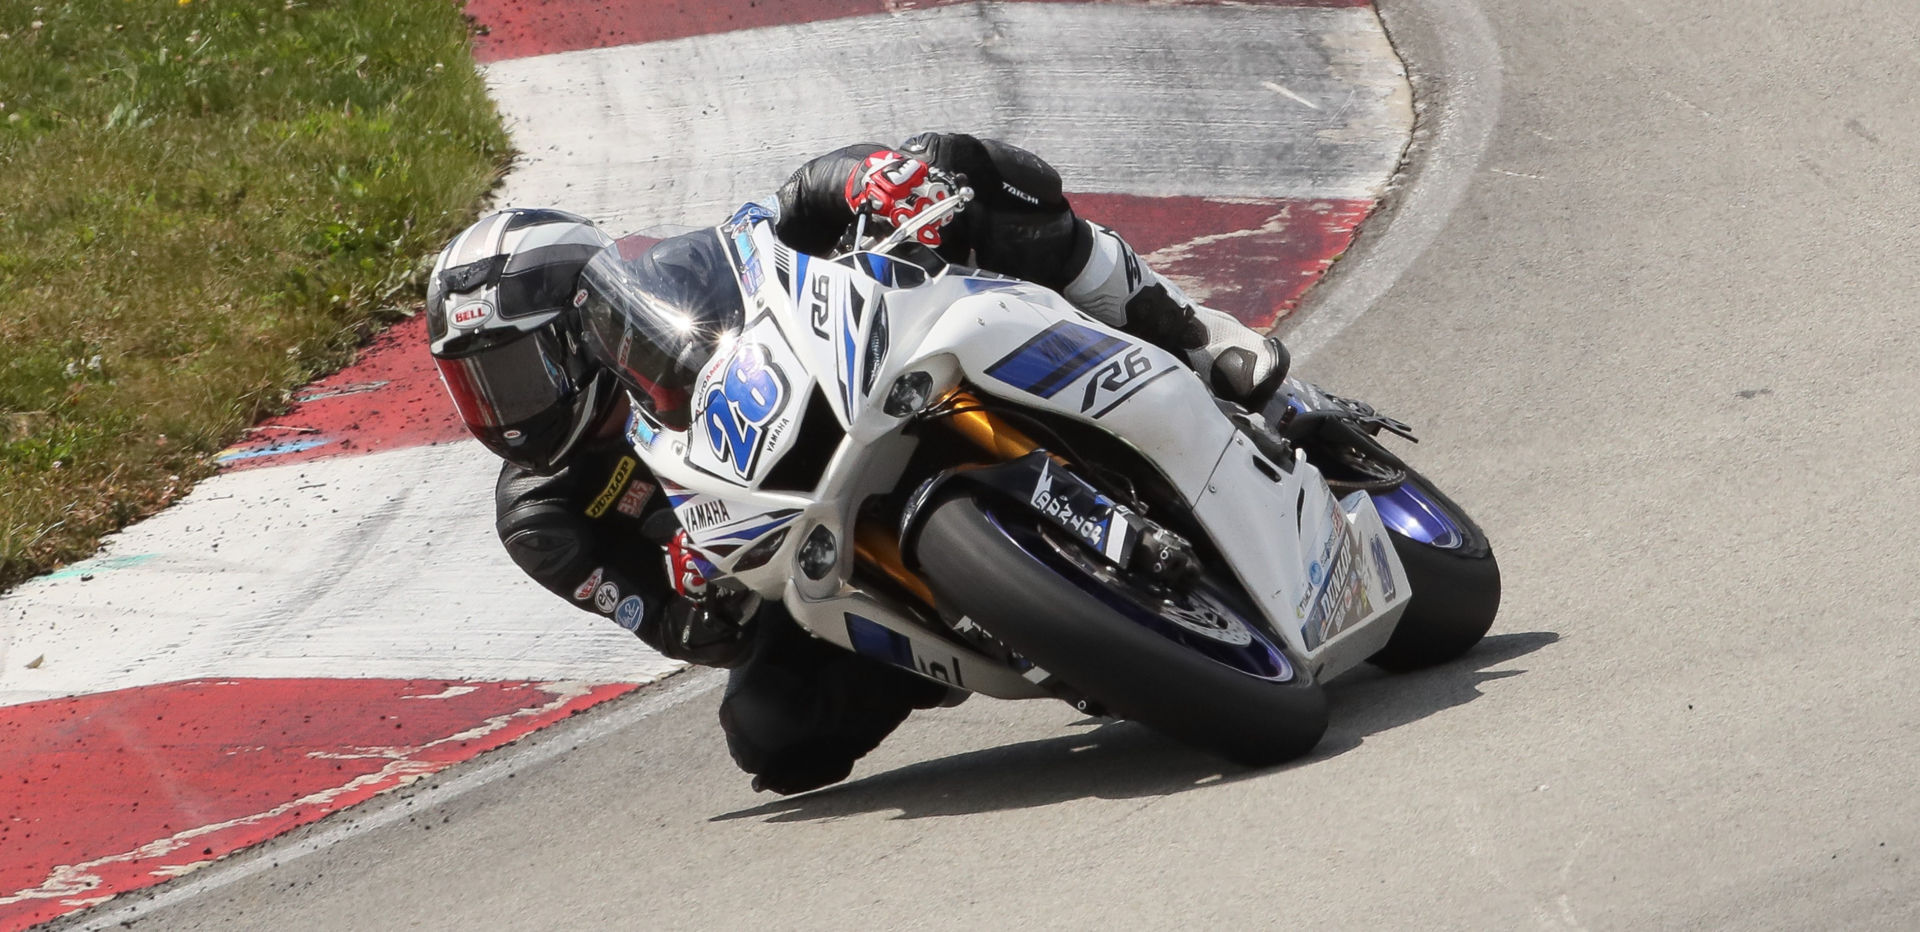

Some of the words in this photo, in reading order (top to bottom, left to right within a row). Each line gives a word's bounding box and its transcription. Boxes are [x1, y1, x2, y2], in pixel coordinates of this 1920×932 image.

[1001, 181, 1039, 205] TAICHI
[455, 307, 485, 324] BELL
[1080, 347, 1152, 413] R6
[705, 344, 787, 480] 28
[766, 418, 790, 453] YAMAHA
[591, 460, 631, 516] DUNLOP
[683, 499, 730, 533] YAMAHA
[1321, 532, 1352, 622] DUNLOP
